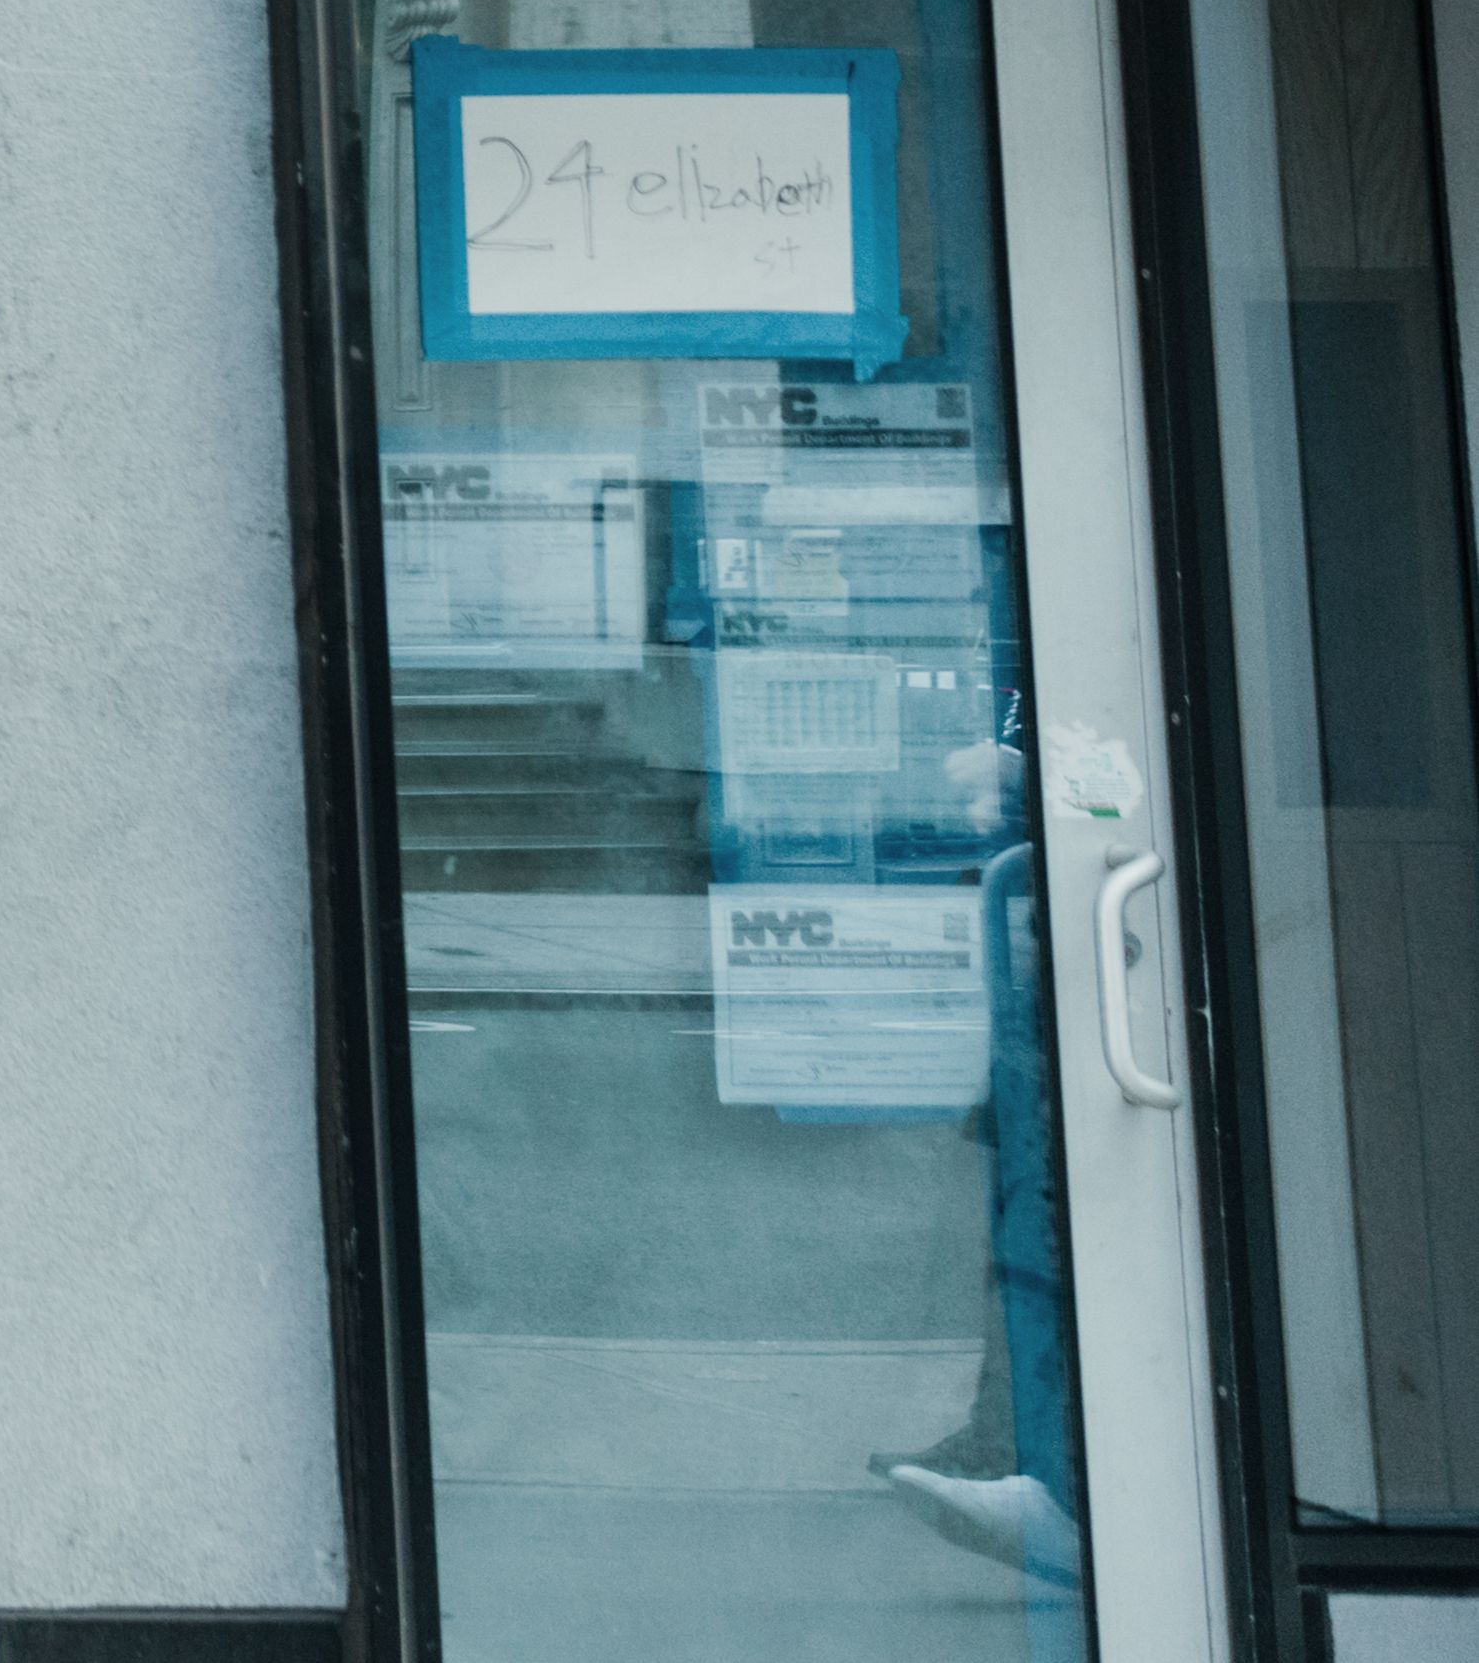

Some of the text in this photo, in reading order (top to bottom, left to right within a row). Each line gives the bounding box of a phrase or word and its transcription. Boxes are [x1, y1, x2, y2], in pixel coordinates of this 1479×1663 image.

[466, 135, 604, 261] 24
[706, 387, 818, 425] NYC
[386, 465, 490, 499] NYC
[730, 910, 835, 946] NYC
